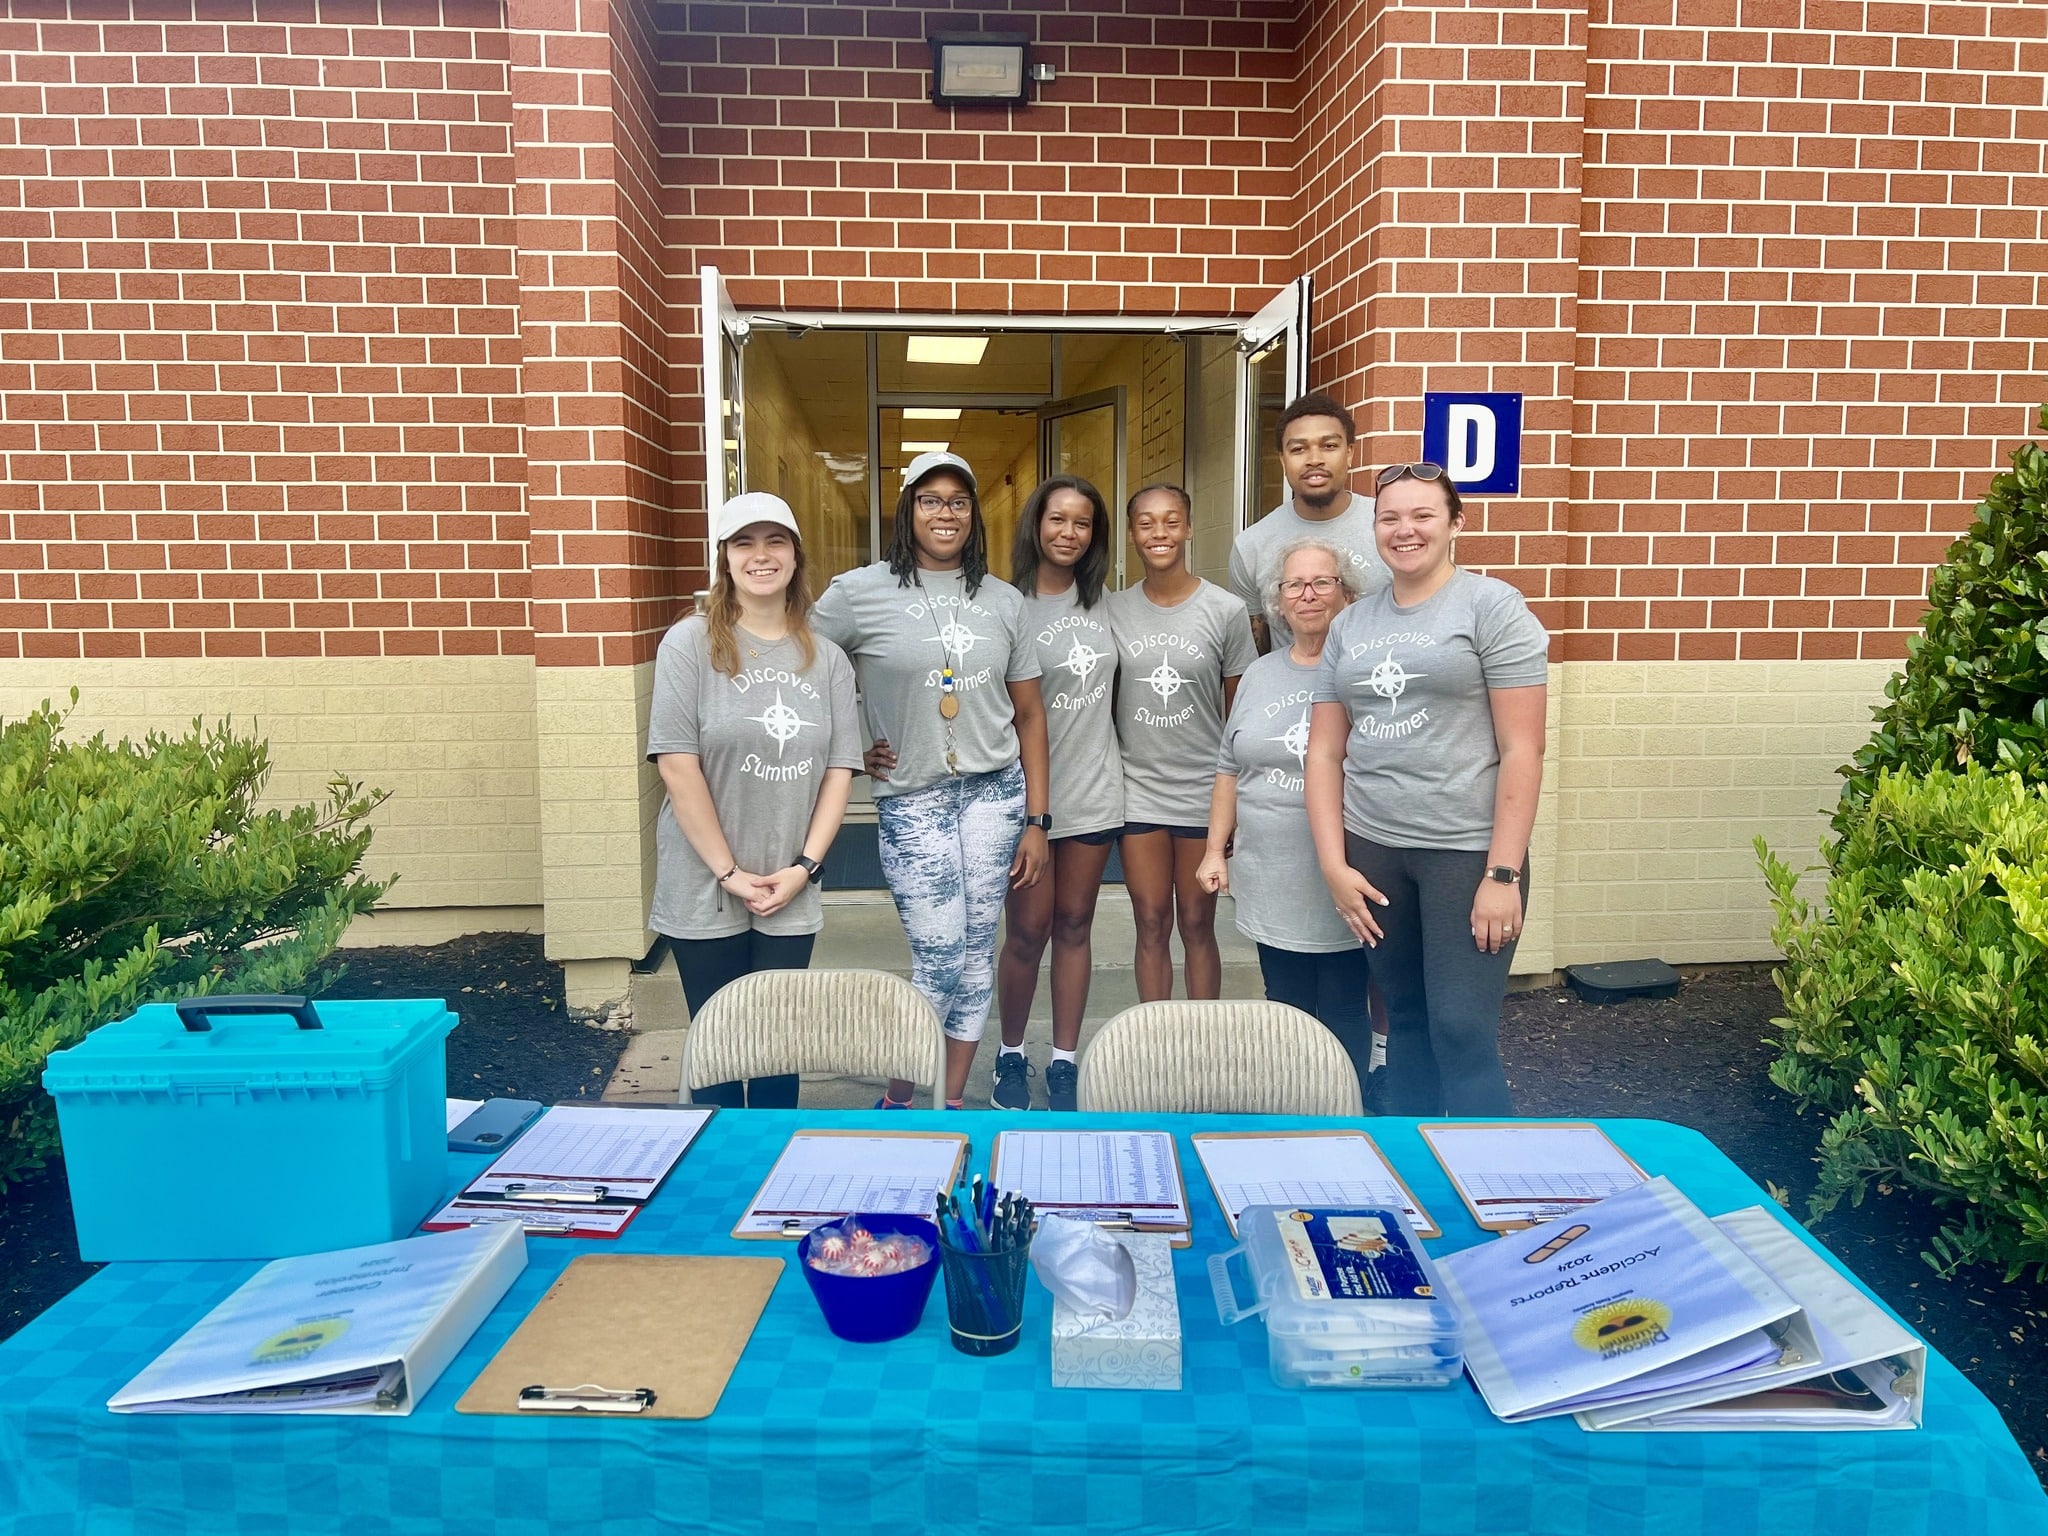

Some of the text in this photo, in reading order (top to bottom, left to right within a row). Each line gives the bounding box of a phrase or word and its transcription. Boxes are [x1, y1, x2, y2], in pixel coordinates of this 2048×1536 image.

[1447, 403, 1496, 482] D
[904, 595, 992, 620] Discover
[1036, 616, 1104, 646] Discover
[1128, 633, 1205, 658] Discover
[1350, 632, 1437, 661] Discover
[729, 667, 820, 694] Discover
[1051, 682, 1107, 710] Summer
[1263, 690, 1314, 719] Disc
[1134, 704, 1195, 728] Summer
[1359, 708, 1430, 739] Summer
[740, 753, 813, 782] Summer
[1266, 768, 1305, 792] Sum
[1557, 1254, 1594, 1273] 2024
[1580, 1246, 1661, 1281] Accident
[1510, 1279, 1580, 1307] Reports
[1602, 1329, 1670, 1361] Discover
